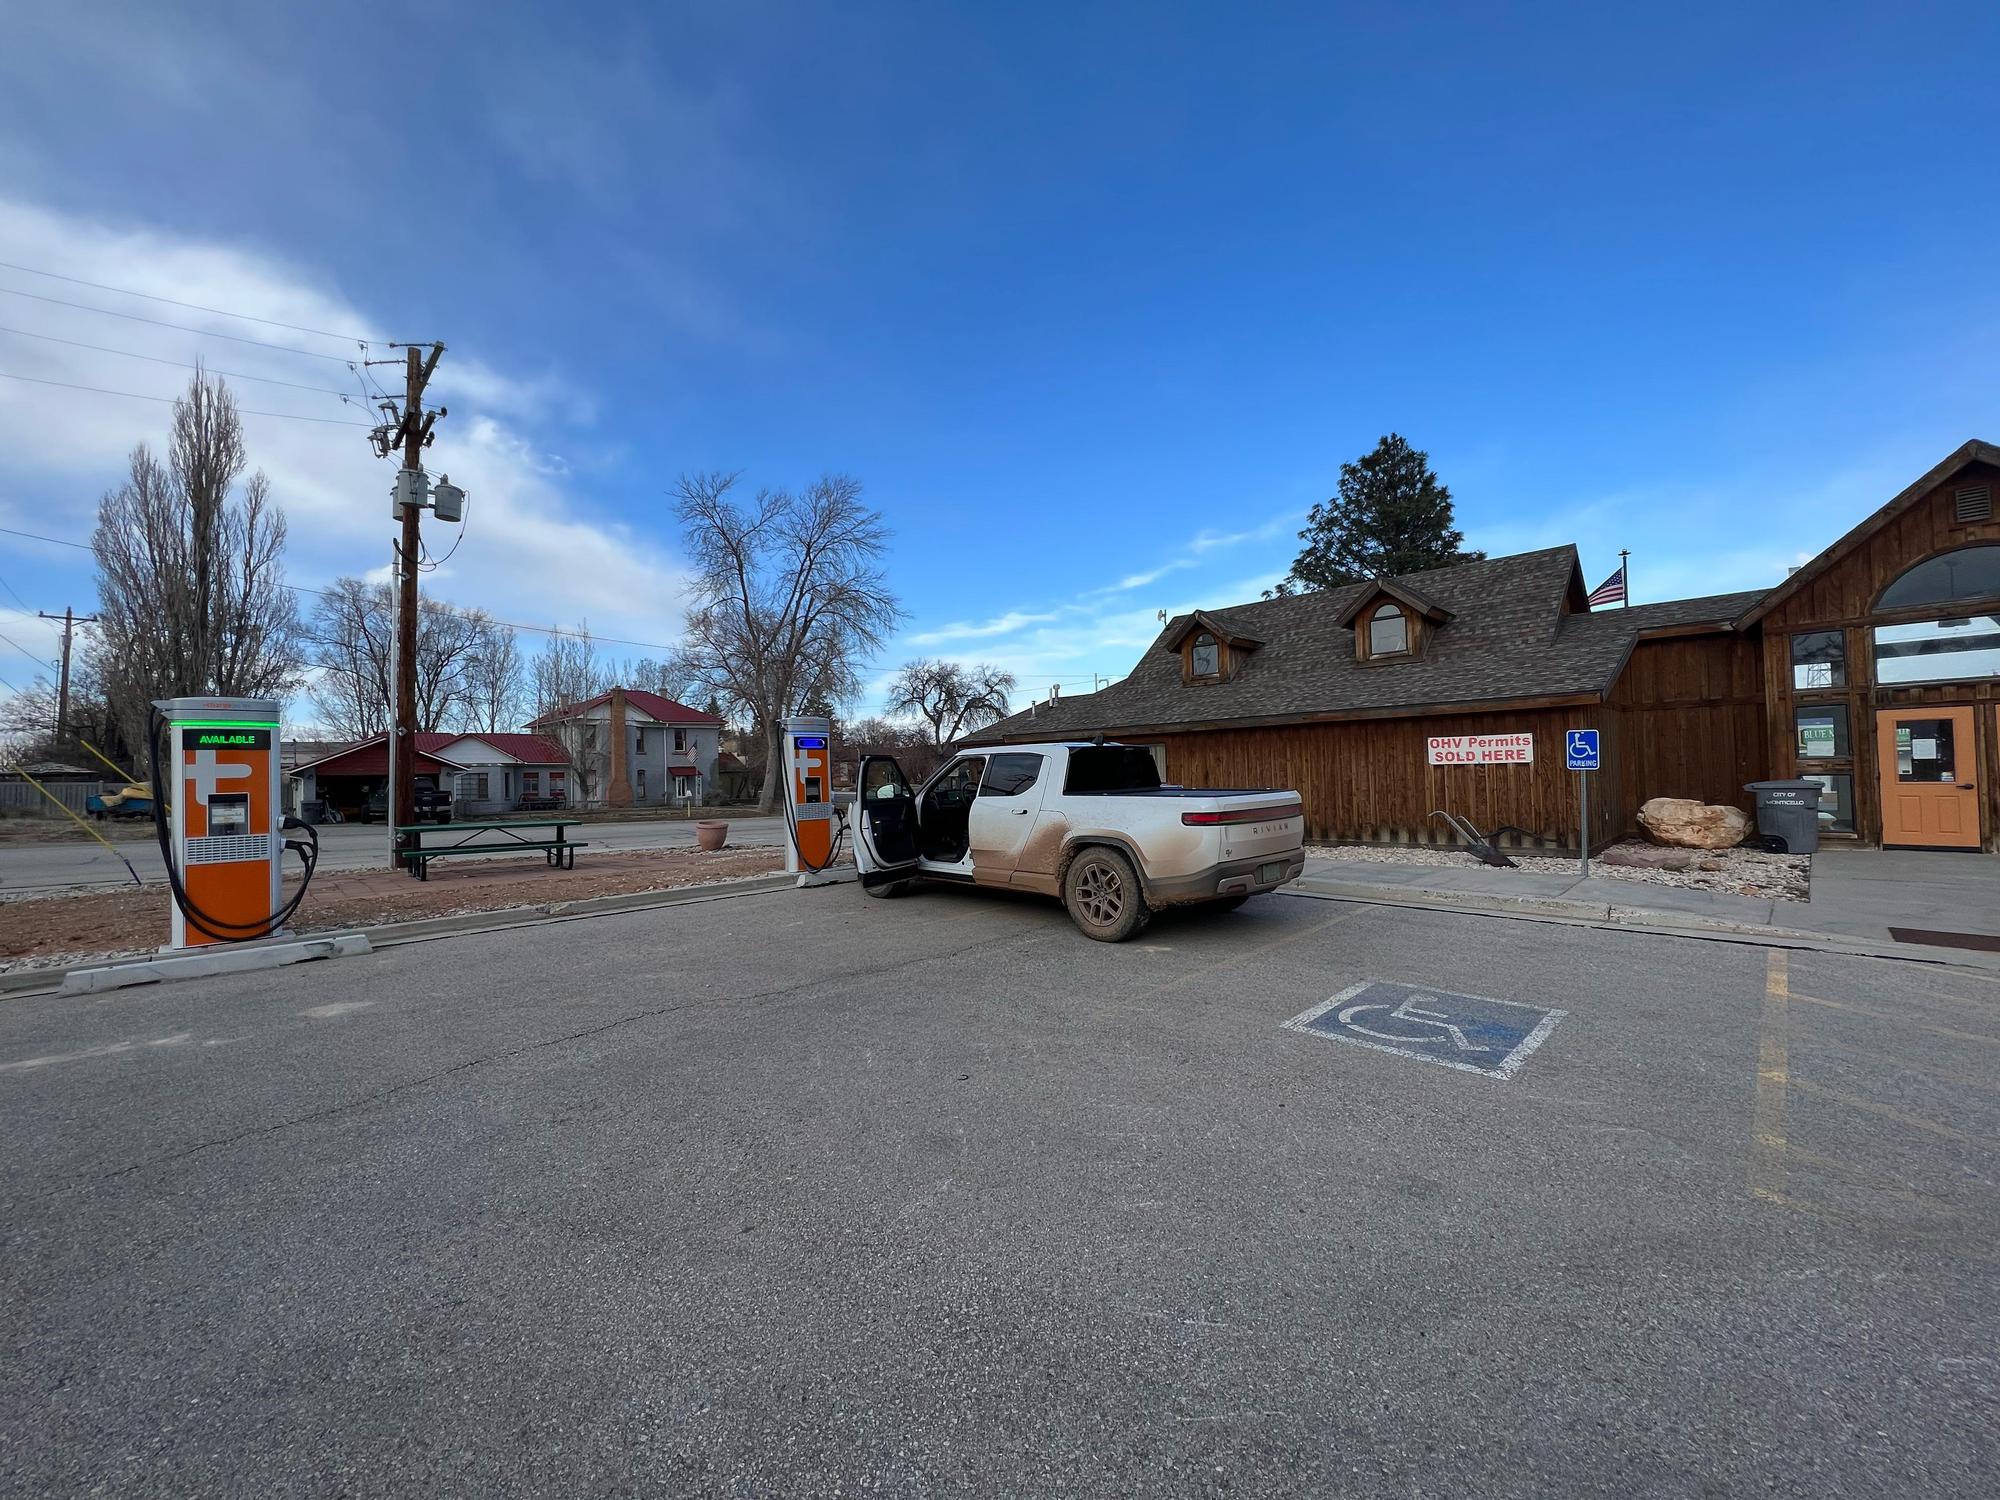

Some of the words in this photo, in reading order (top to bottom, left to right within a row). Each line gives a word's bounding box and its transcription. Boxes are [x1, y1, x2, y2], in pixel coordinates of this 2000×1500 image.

[1804, 730, 1826, 738] BLUE
[200, 735, 255, 744] AVAILABLE
[1430, 738, 1462, 749] OHV
[1468, 736, 1531, 748] Permits
[1435, 751, 1476, 762] SOLD
[1482, 749, 1527, 761] HERE
[1569, 759, 1597, 767] PARKING
[1252, 823, 1289, 835] RIVIAN
